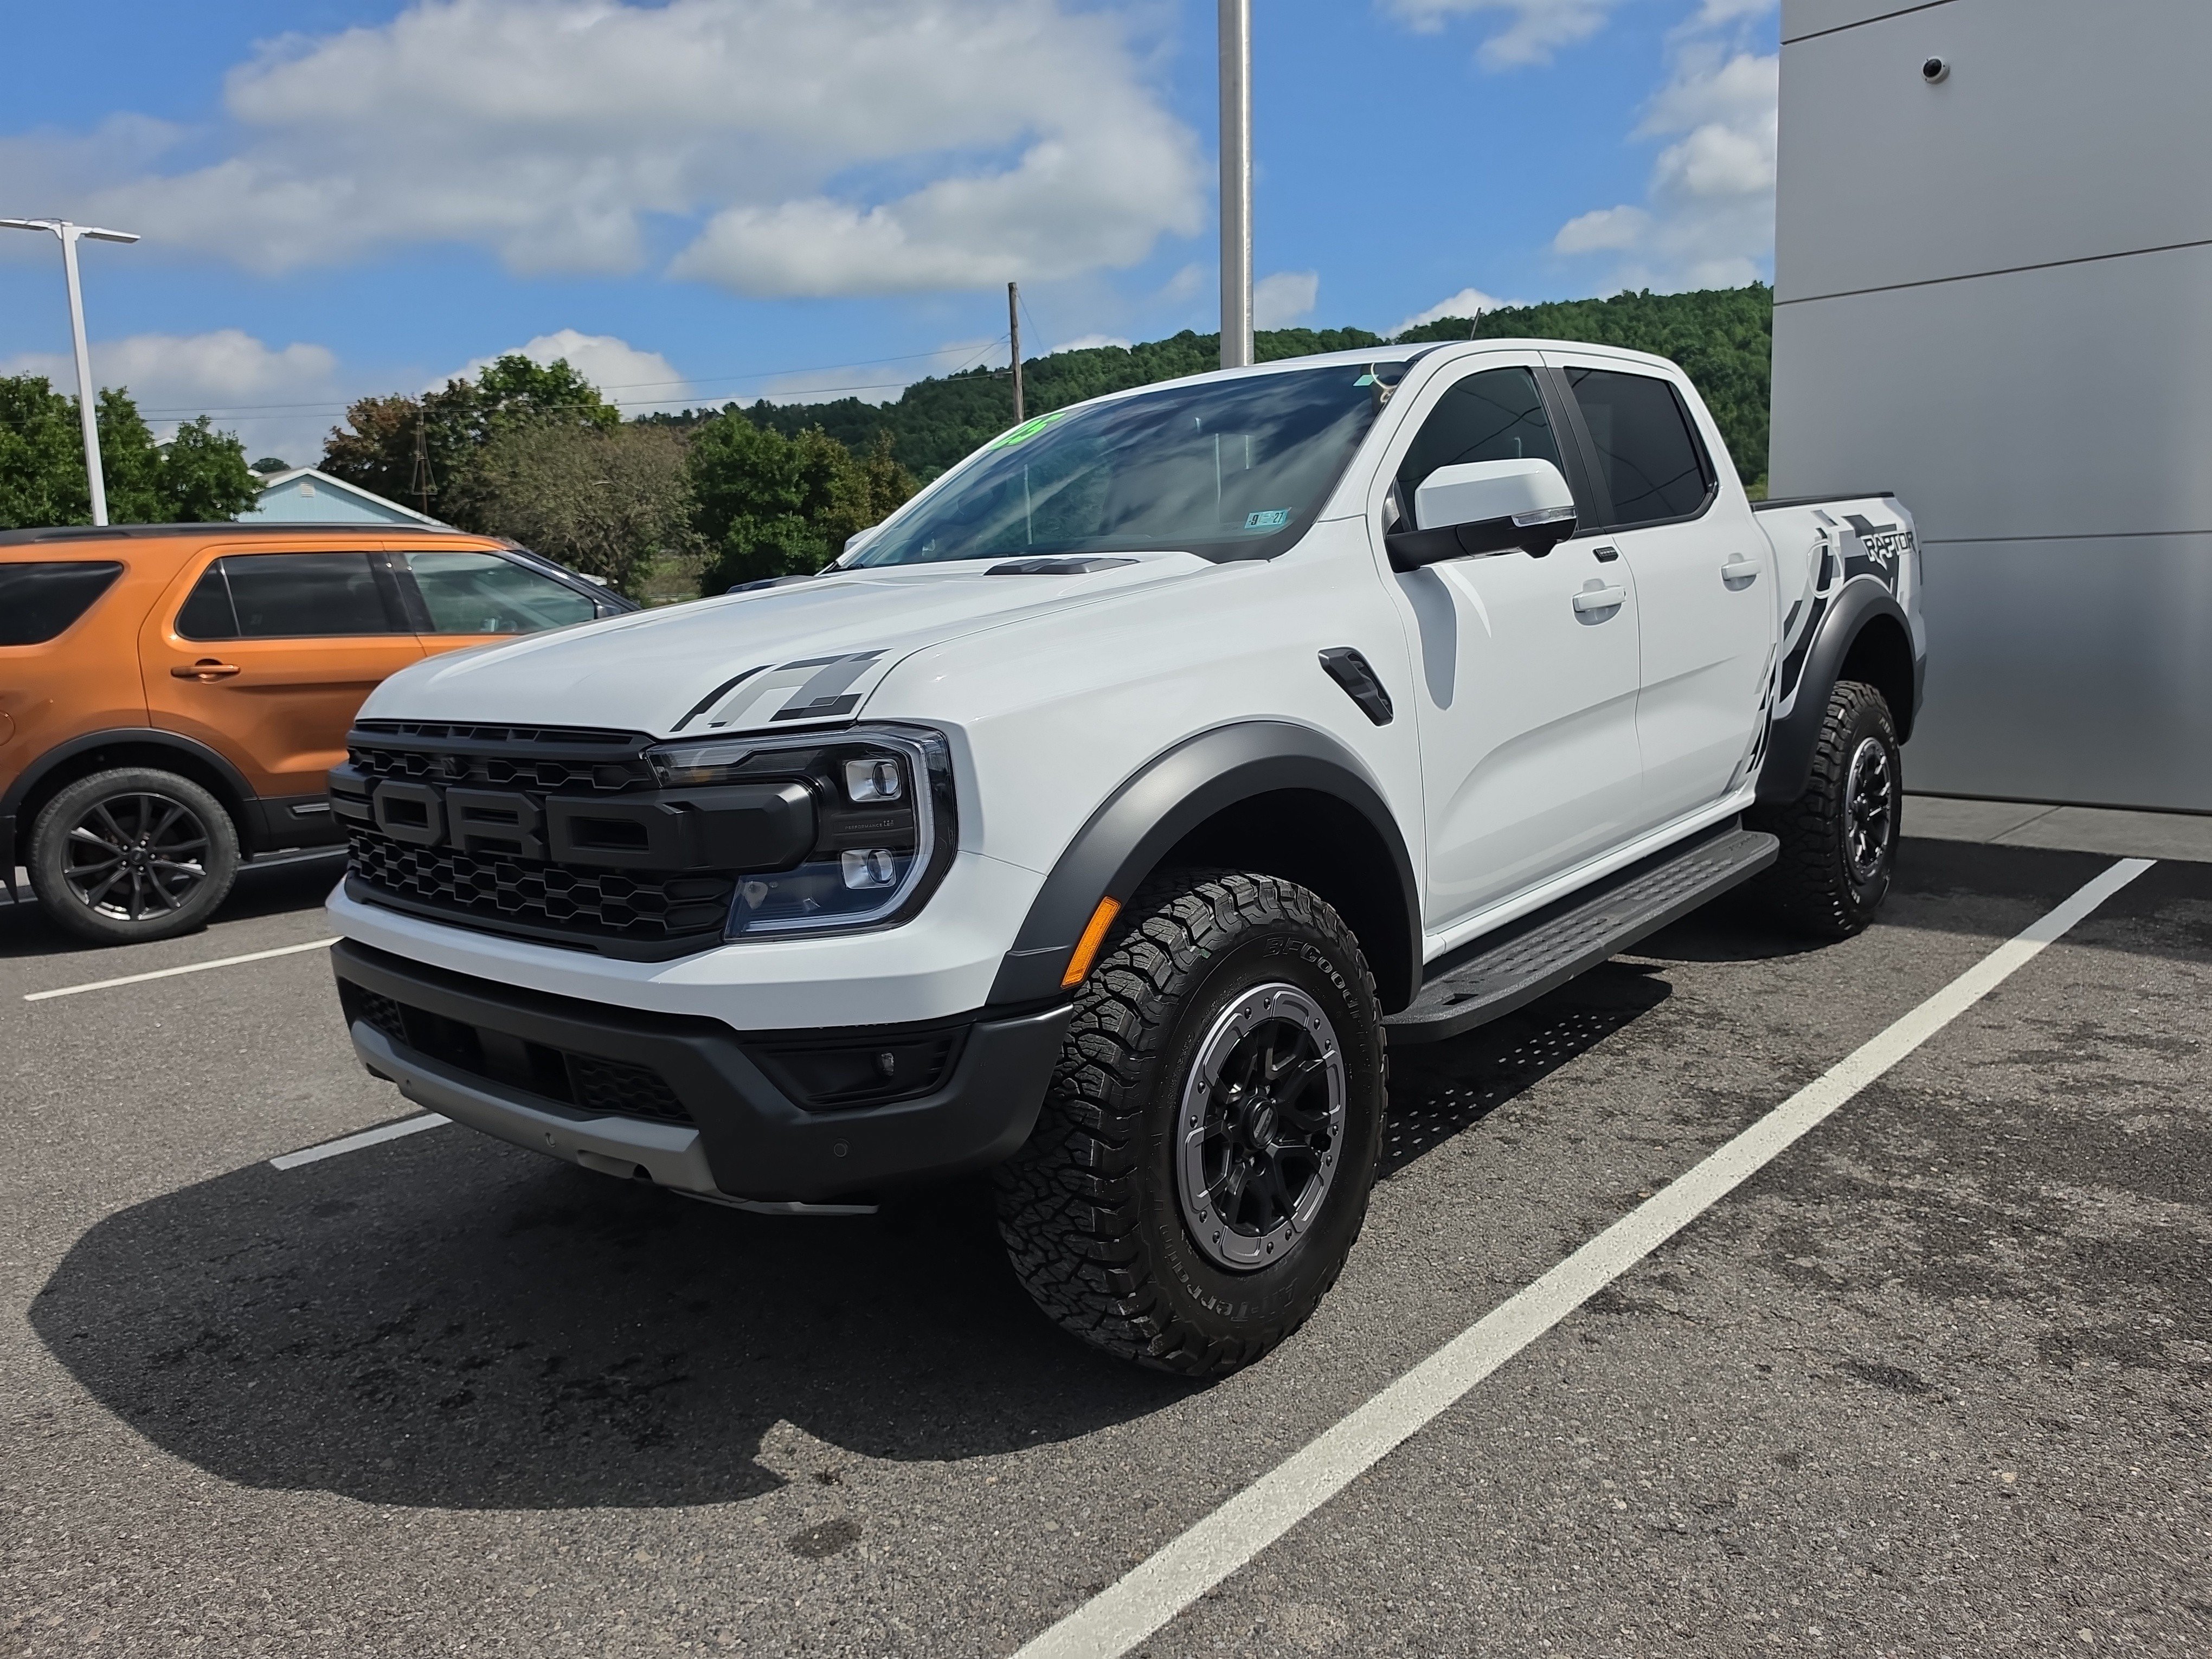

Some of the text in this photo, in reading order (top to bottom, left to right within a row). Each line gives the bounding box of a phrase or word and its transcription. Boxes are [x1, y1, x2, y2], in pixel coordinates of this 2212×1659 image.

[1273, 512, 1283, 523] 27
[1860, 530, 1918, 569] RAPTOR
[1262, 936, 1371, 1066] BFGoodri
